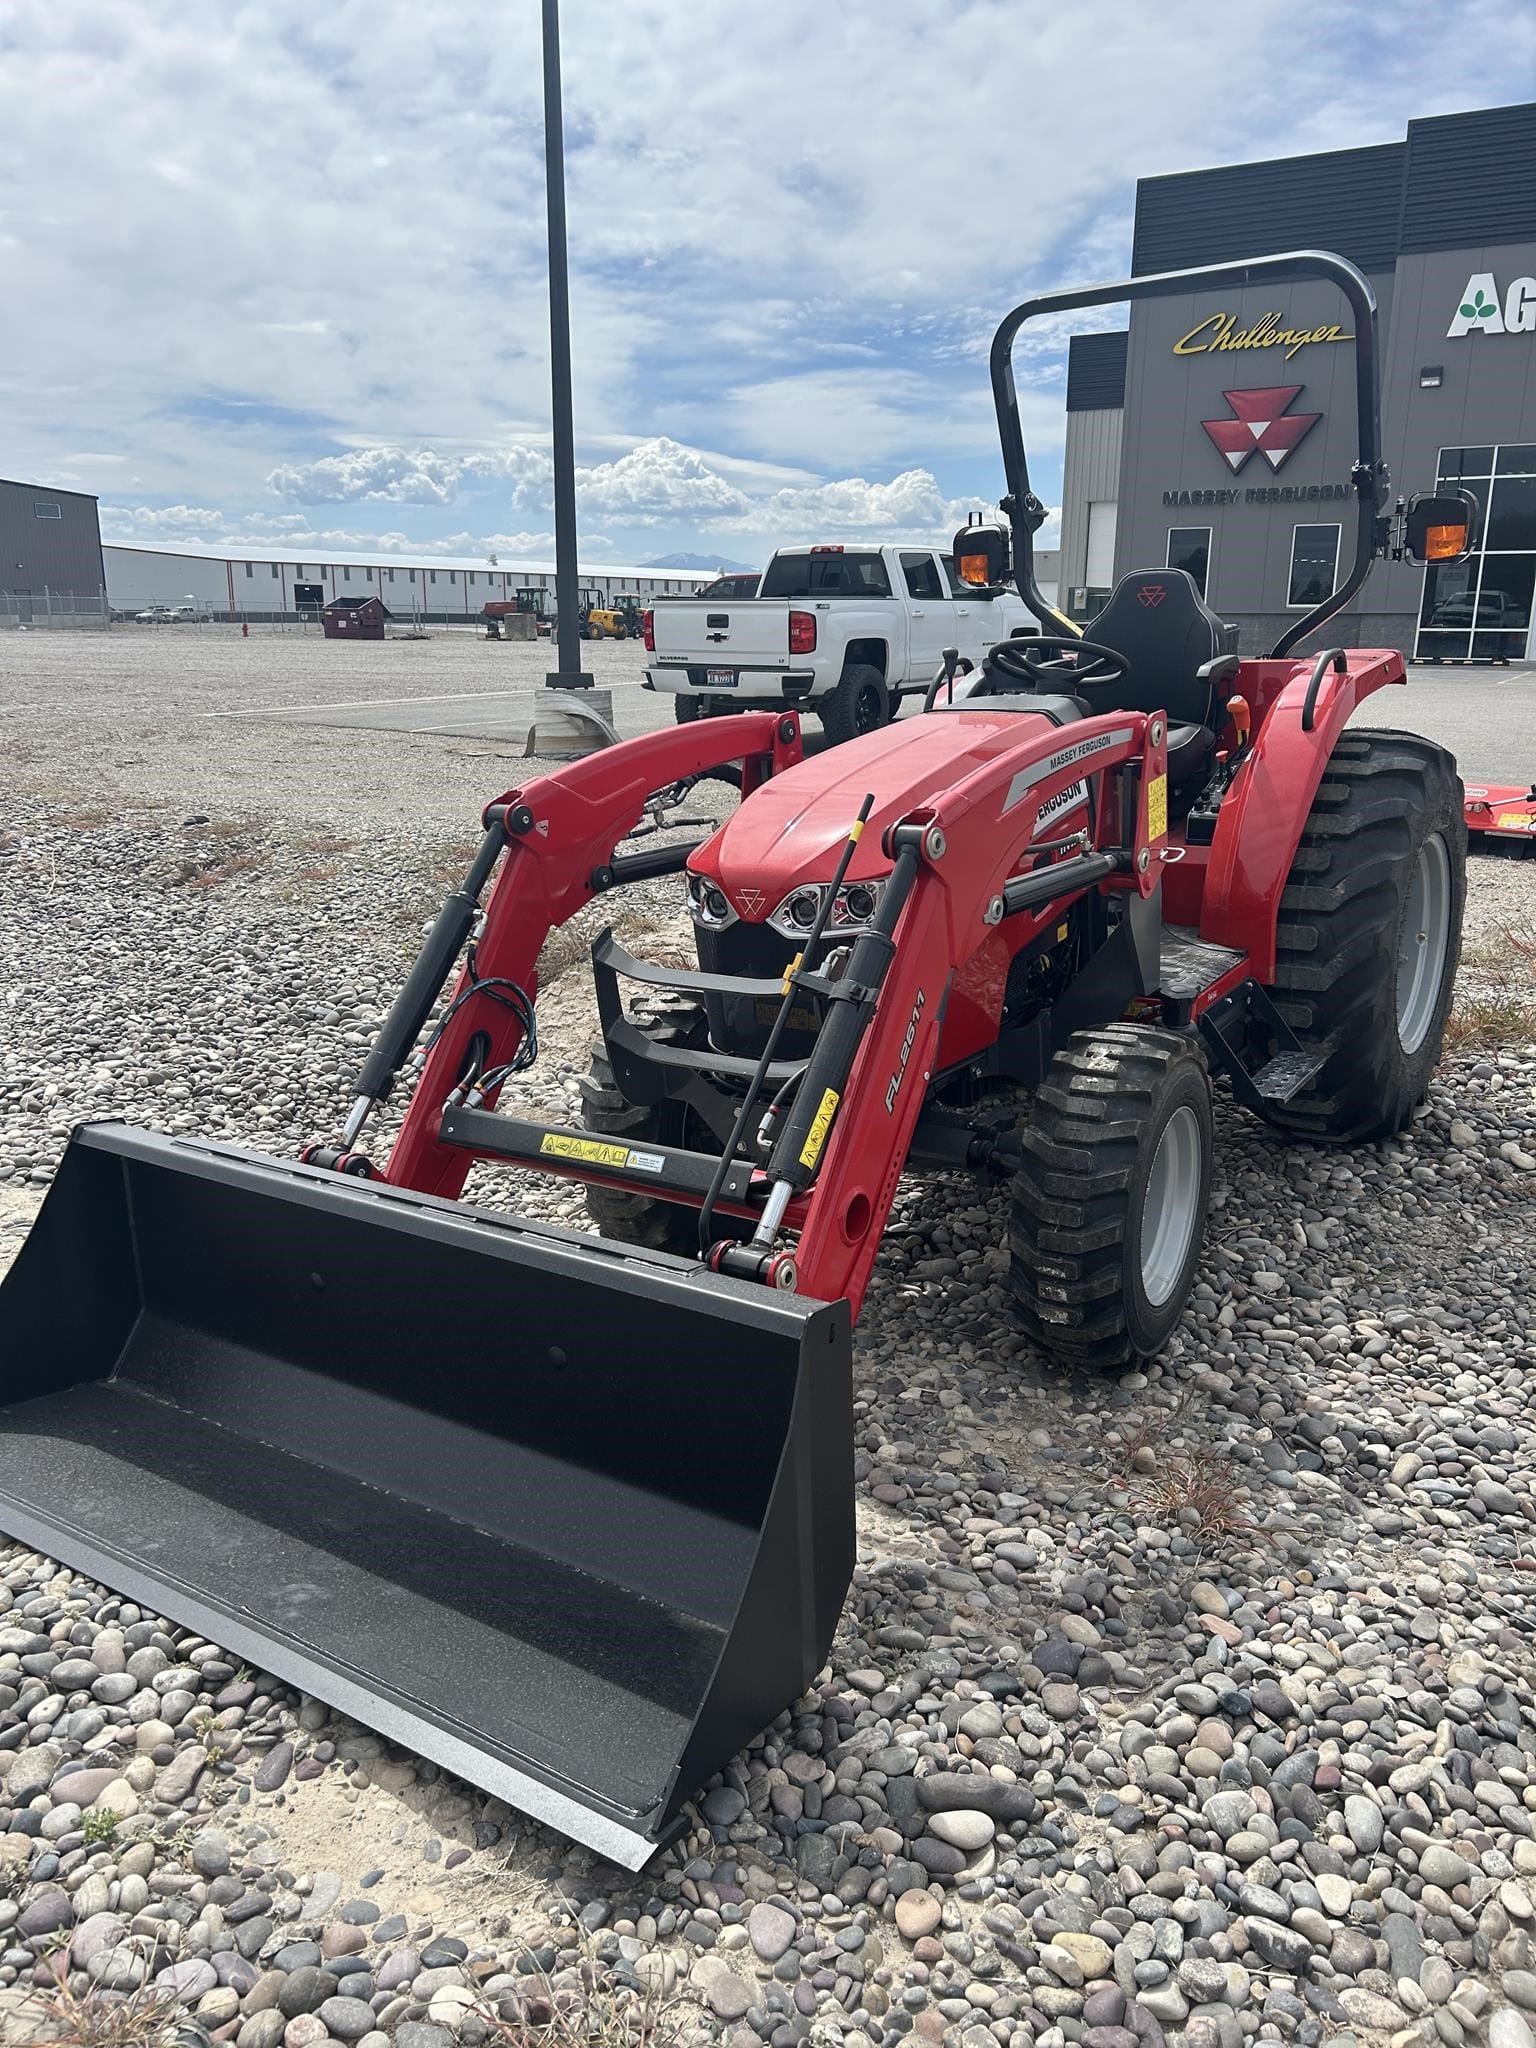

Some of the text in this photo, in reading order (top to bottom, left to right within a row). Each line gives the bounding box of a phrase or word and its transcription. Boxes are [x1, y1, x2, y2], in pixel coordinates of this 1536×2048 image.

[1173, 312, 1356, 360] Challenger
[1162, 484, 1350, 506] MASSEY FERGUSON
[1050, 735, 1111, 770] MASSEY FERGUSON
[1038, 781, 1082, 820] ERGUSON
